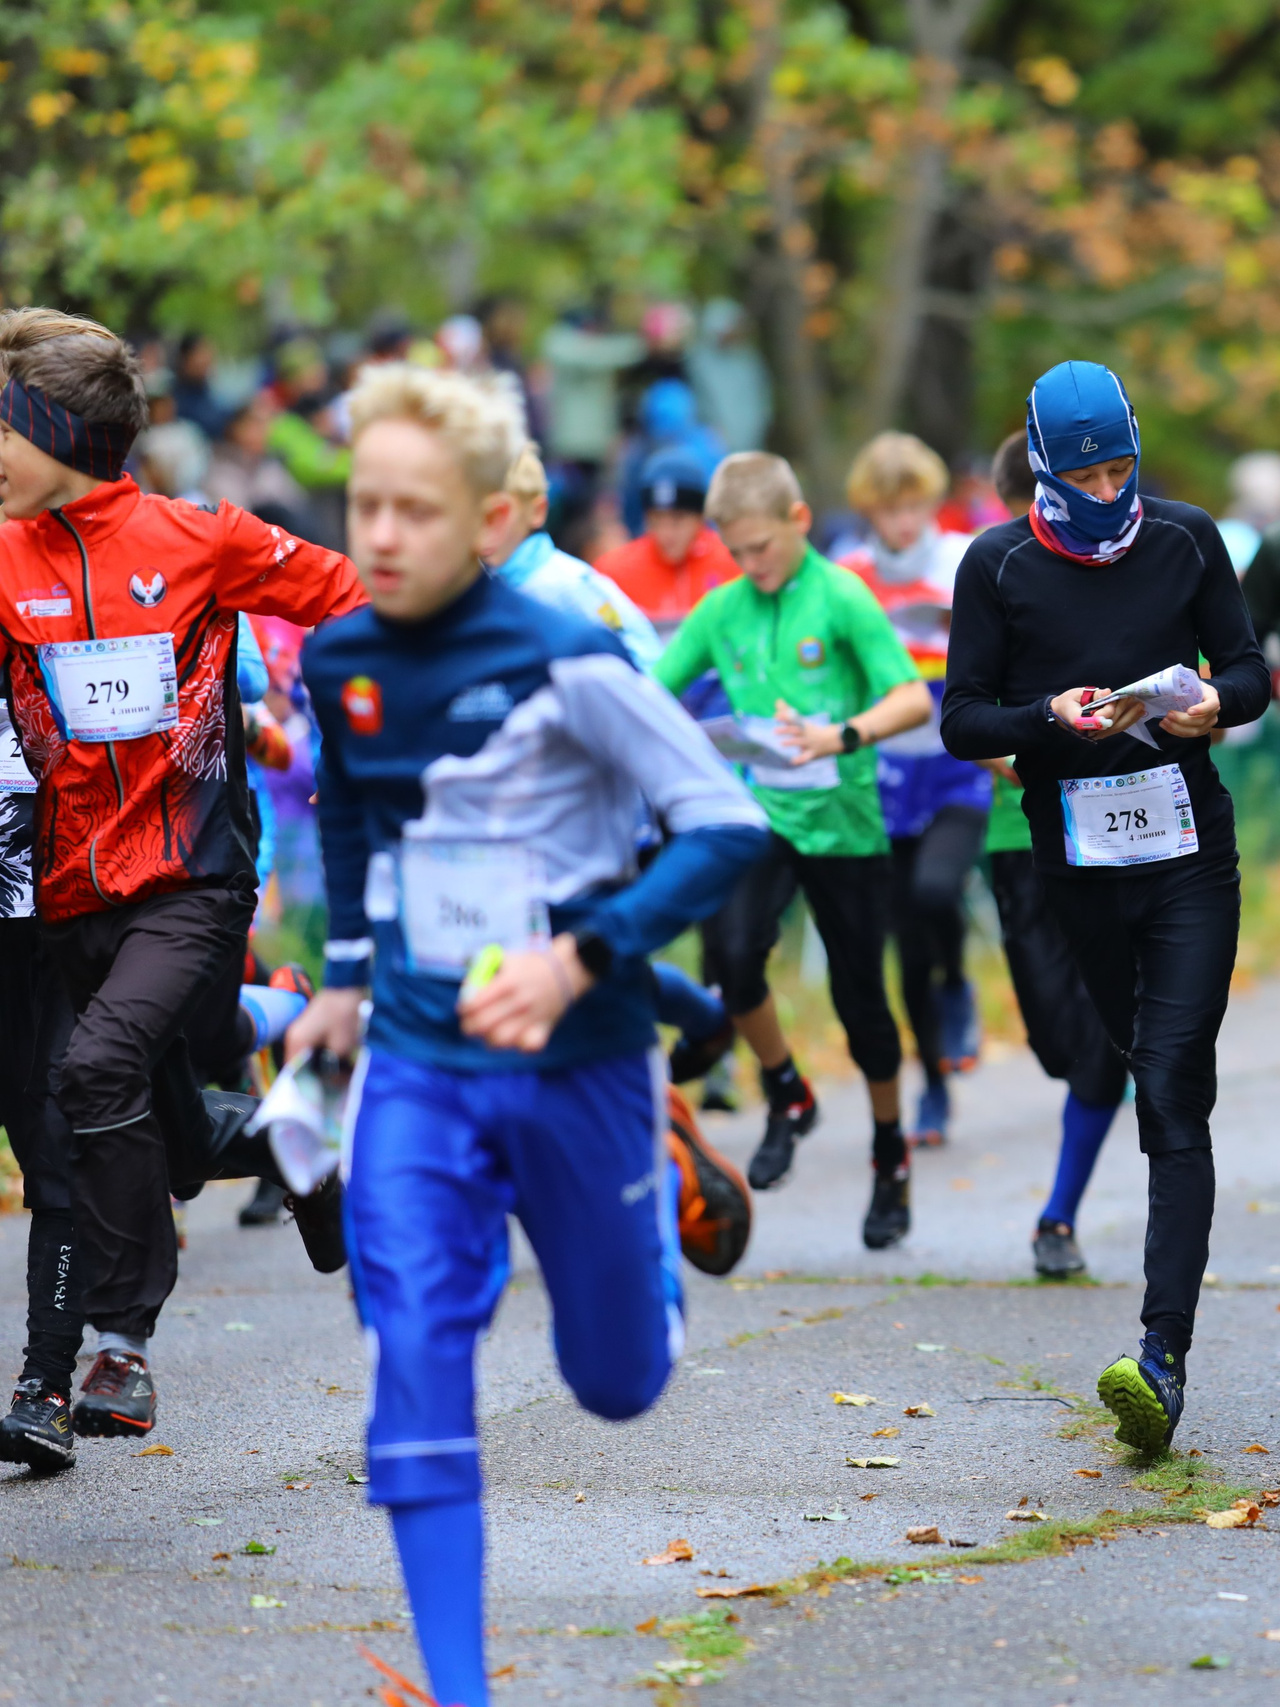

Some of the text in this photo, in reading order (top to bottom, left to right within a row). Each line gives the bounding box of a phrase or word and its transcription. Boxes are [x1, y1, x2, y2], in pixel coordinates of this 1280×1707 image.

[85, 679, 129, 704] 279
[110, 705, 150, 715] 4 линия
[10, 737, 22, 757] 2
[1105, 808, 1148, 832] 278
[1129, 834, 1134, 842] 4
[1137, 831, 1166, 841] линия
